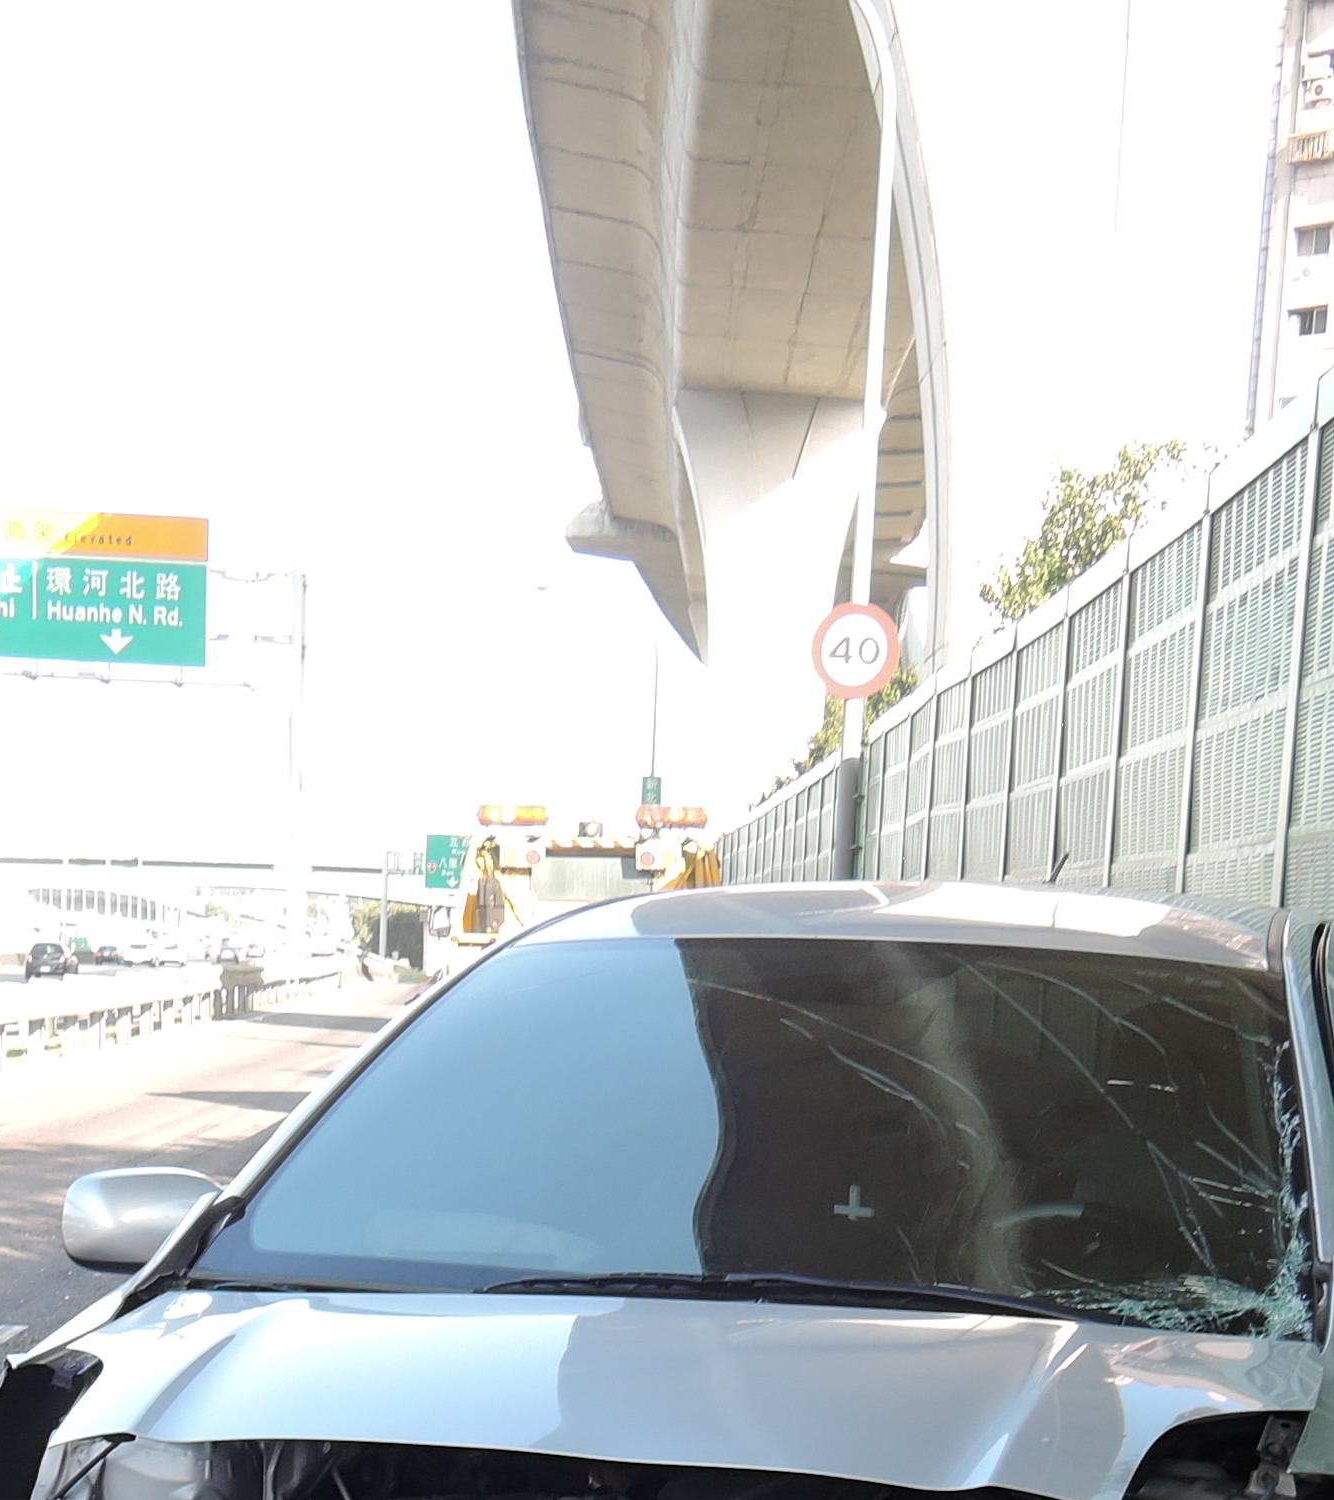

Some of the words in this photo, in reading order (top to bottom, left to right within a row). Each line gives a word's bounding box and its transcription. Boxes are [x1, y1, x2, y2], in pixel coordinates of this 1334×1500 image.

[46, 567, 182, 601] 環河北路
[47, 602, 122, 623] Huanhe
[129, 604, 147, 625] N.
[154, 607, 183, 627] Rd.
[829, 637, 879, 664] 40
